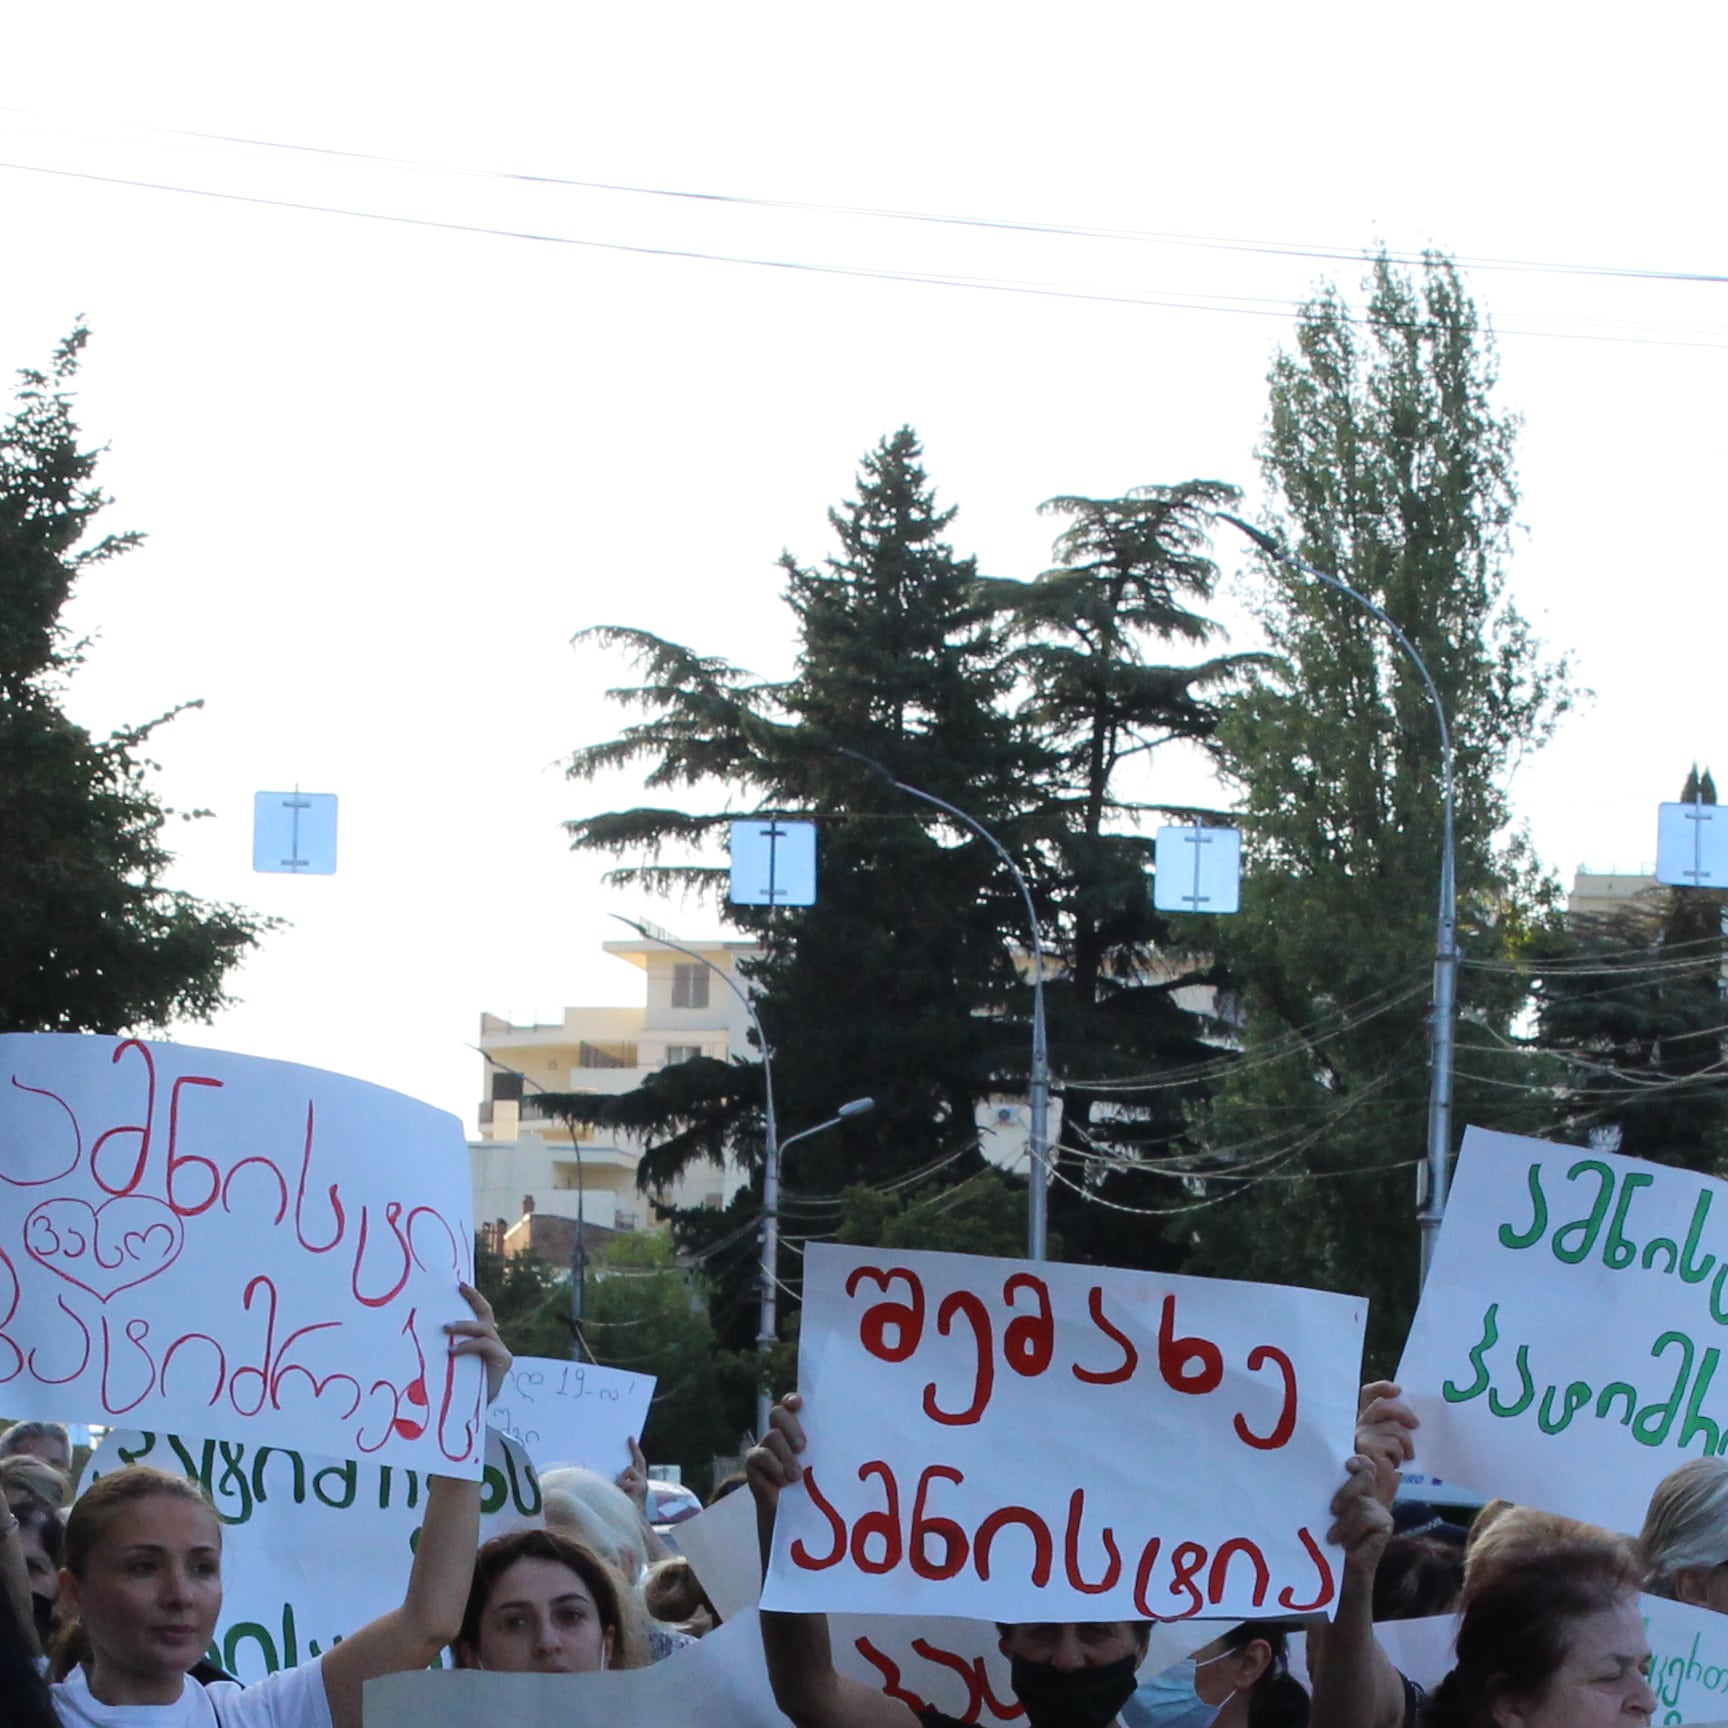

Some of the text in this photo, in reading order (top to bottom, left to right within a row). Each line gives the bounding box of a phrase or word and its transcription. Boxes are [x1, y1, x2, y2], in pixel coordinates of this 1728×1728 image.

[33, 1215, 175, 1269] ვასო
[846, 1265, 1298, 1450] შემახე
[790, 1460, 1335, 1623] ამნისტია
